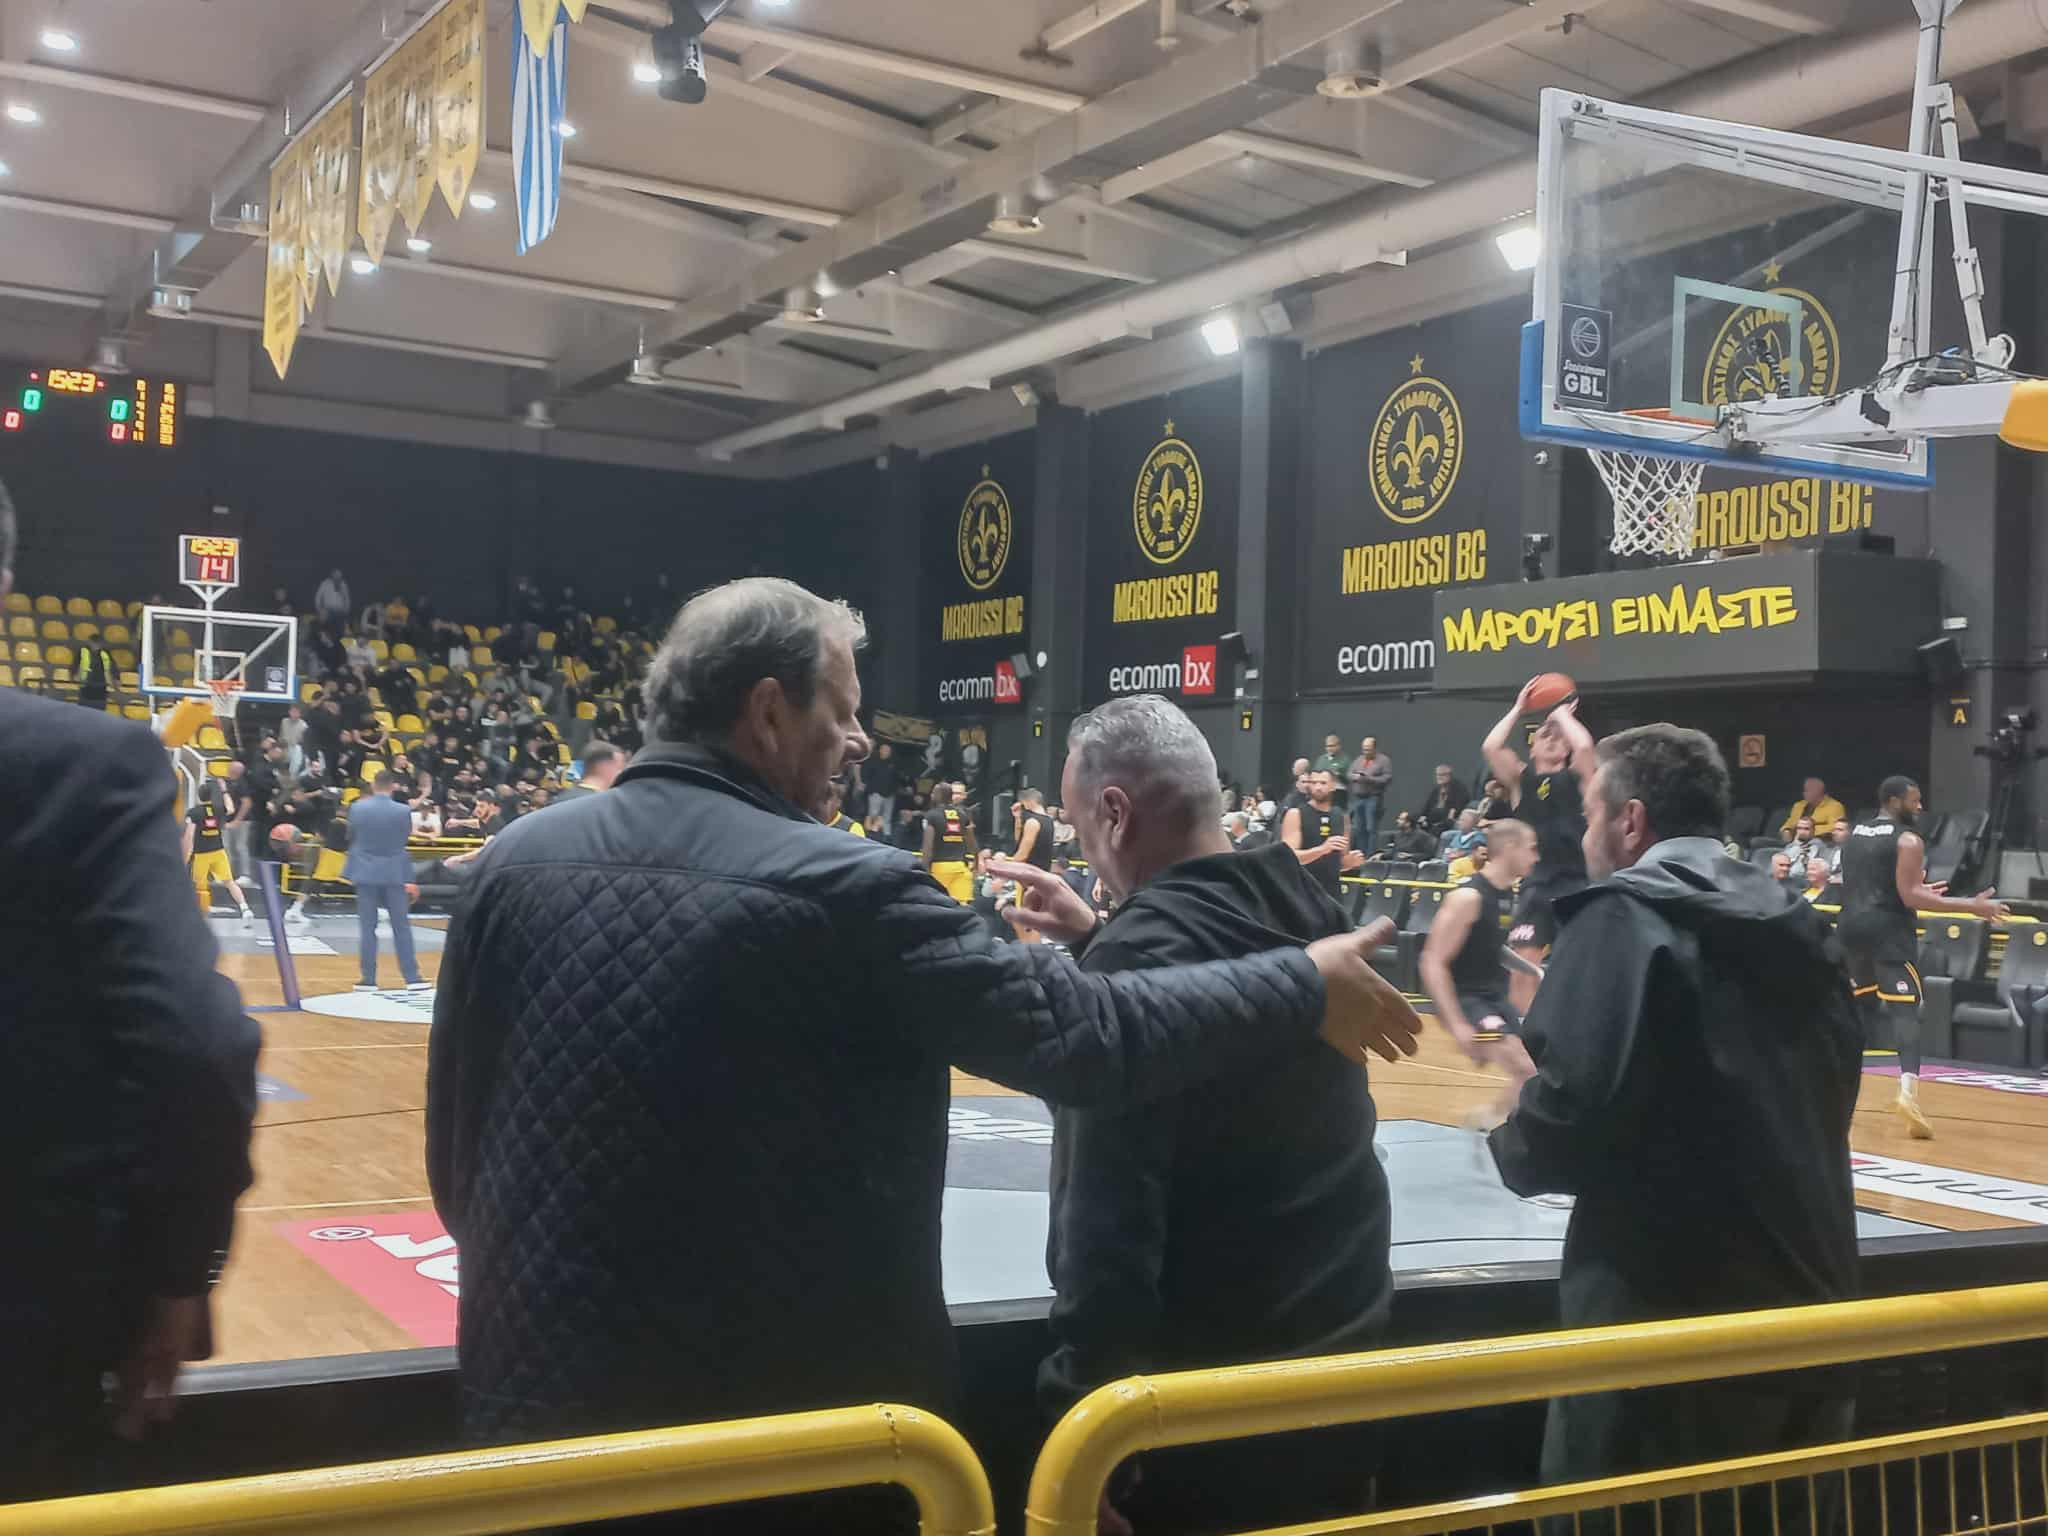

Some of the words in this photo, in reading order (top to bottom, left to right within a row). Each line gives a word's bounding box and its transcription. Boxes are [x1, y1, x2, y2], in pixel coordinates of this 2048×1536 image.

[1564, 373, 1604, 397] GBL
[24, 389, 41, 411] 0
[111, 400, 128, 421] 0
[5, 411, 20, 428] 0
[112, 423, 126, 440] 0
[201, 557, 229, 581] 14
[1342, 534, 1452, 594] MAROUSSI
[1456, 529, 1487, 582] BC
[1113, 575, 1194, 622] MAROUSSI
[1196, 570, 1219, 614] BC
[942, 601, 1003, 640] MAROUSSI
[1007, 597, 1024, 634] BC
